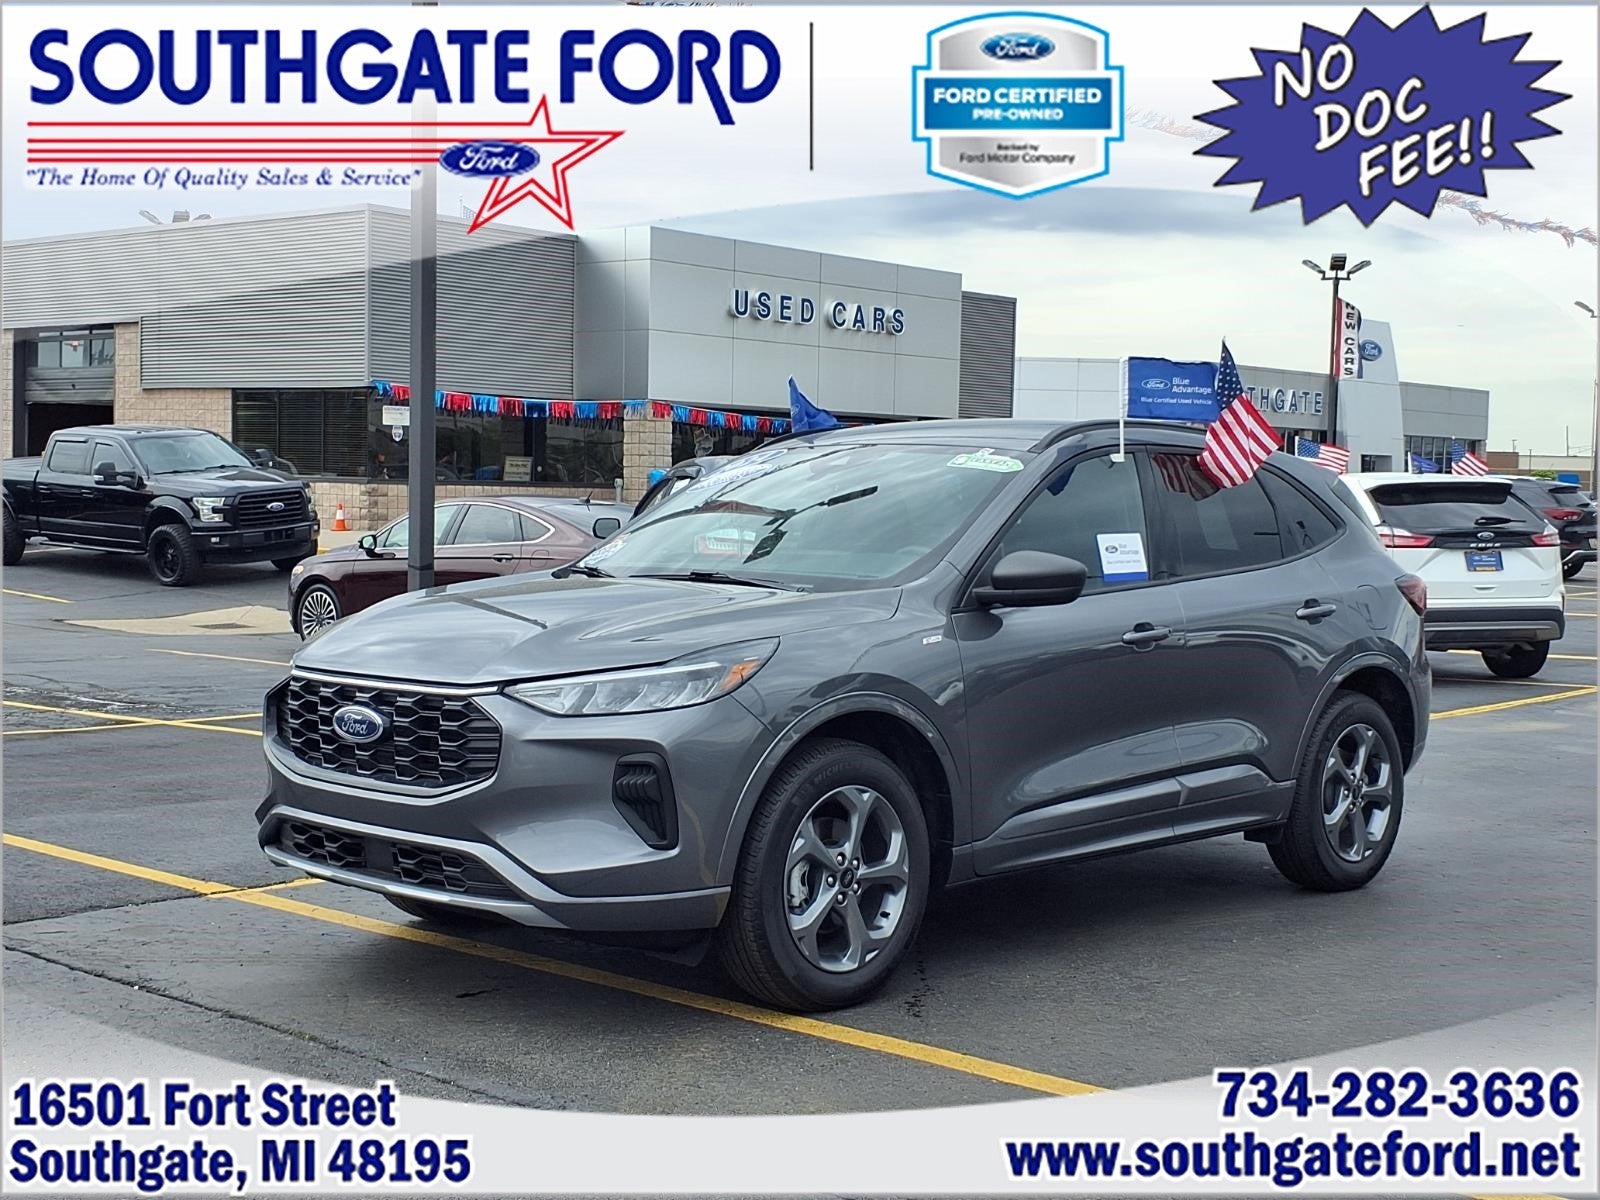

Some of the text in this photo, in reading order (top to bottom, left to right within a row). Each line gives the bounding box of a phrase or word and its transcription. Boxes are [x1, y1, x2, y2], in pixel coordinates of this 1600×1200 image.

[733, 288, 905, 335] USED CARS
[1343, 301, 1356, 376] NEW CARS
[1171, 385, 1213, 395] Advantage
[1172, 377, 1191, 385] Blue
